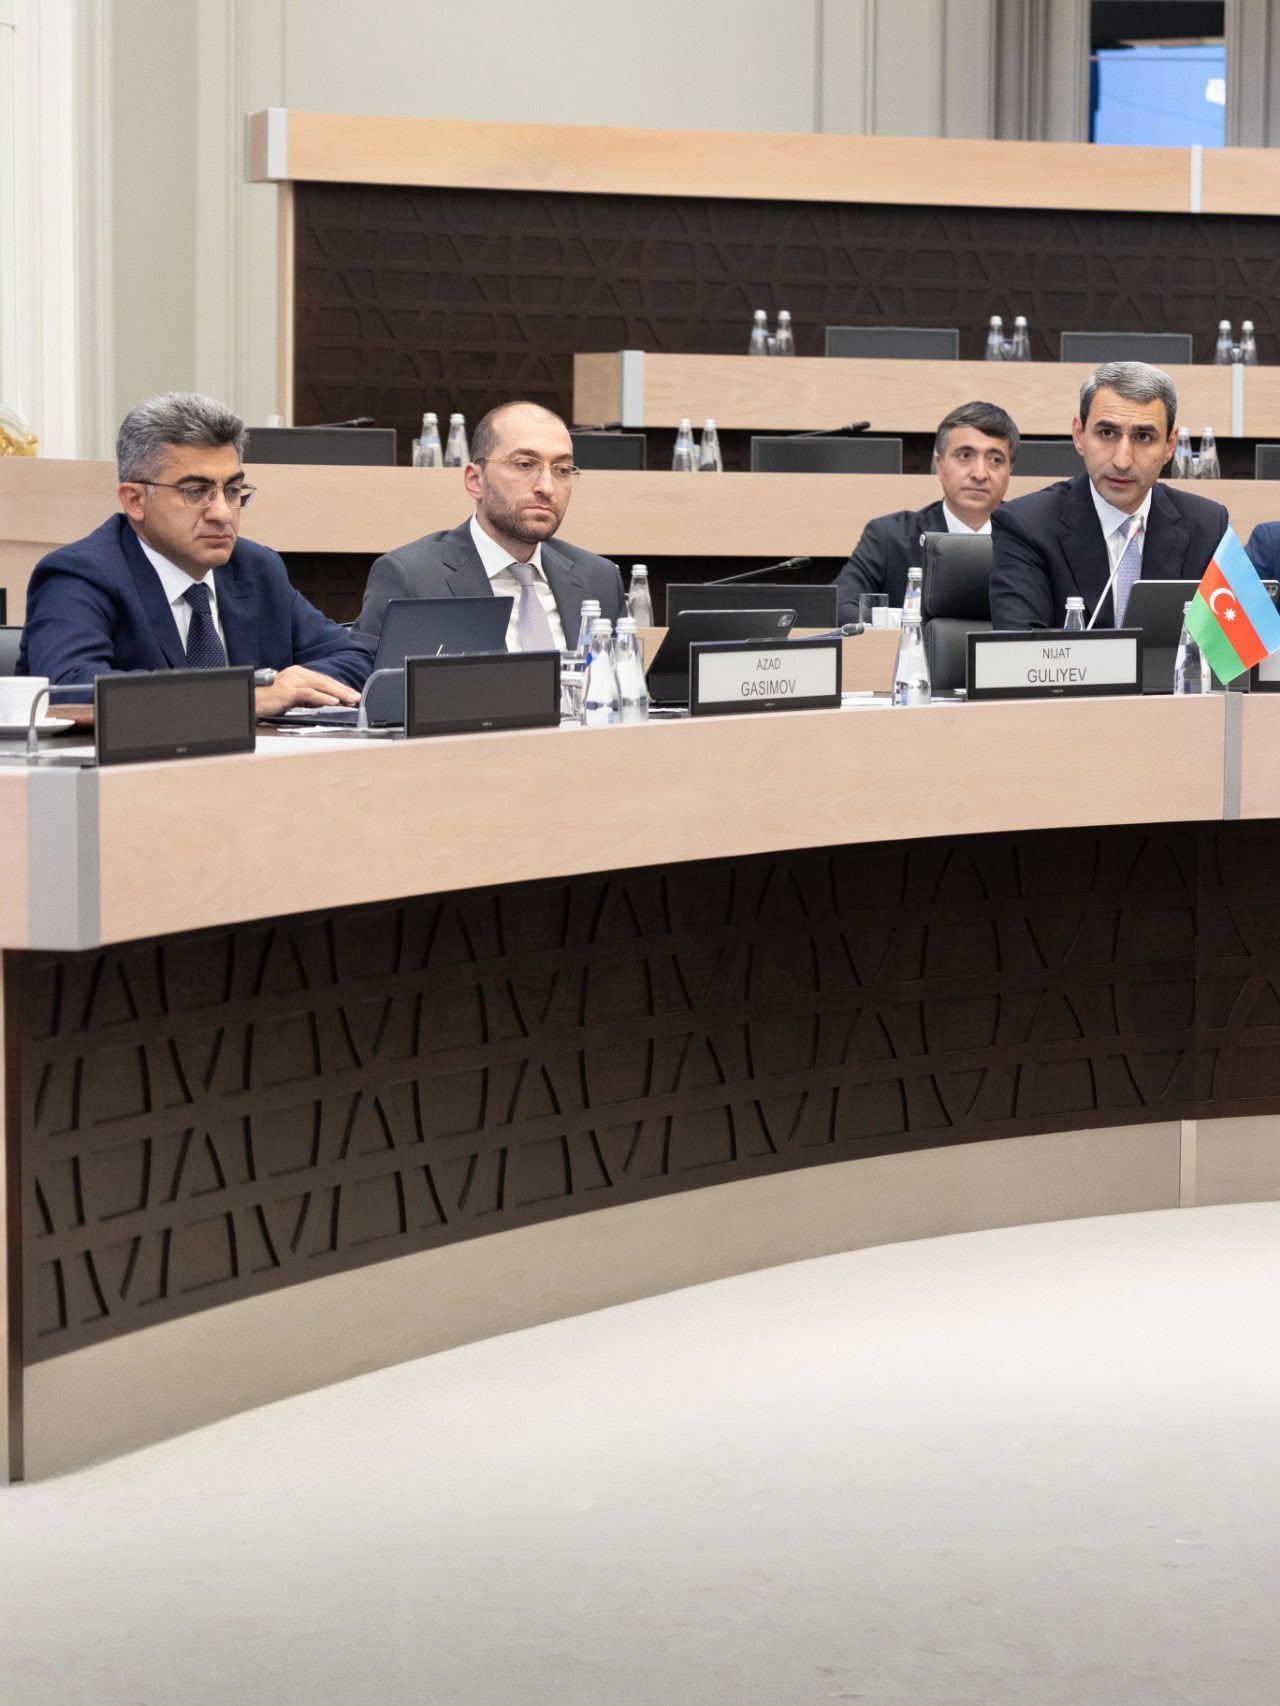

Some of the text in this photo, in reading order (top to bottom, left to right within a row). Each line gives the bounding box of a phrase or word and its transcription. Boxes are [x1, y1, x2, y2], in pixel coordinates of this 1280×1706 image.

[1042, 647, 1071, 659] NIJAT
[756, 658, 781, 670] AZAD
[1027, 667, 1087, 683] GULIYEV
[741, 679, 796, 696] GASIMOV
